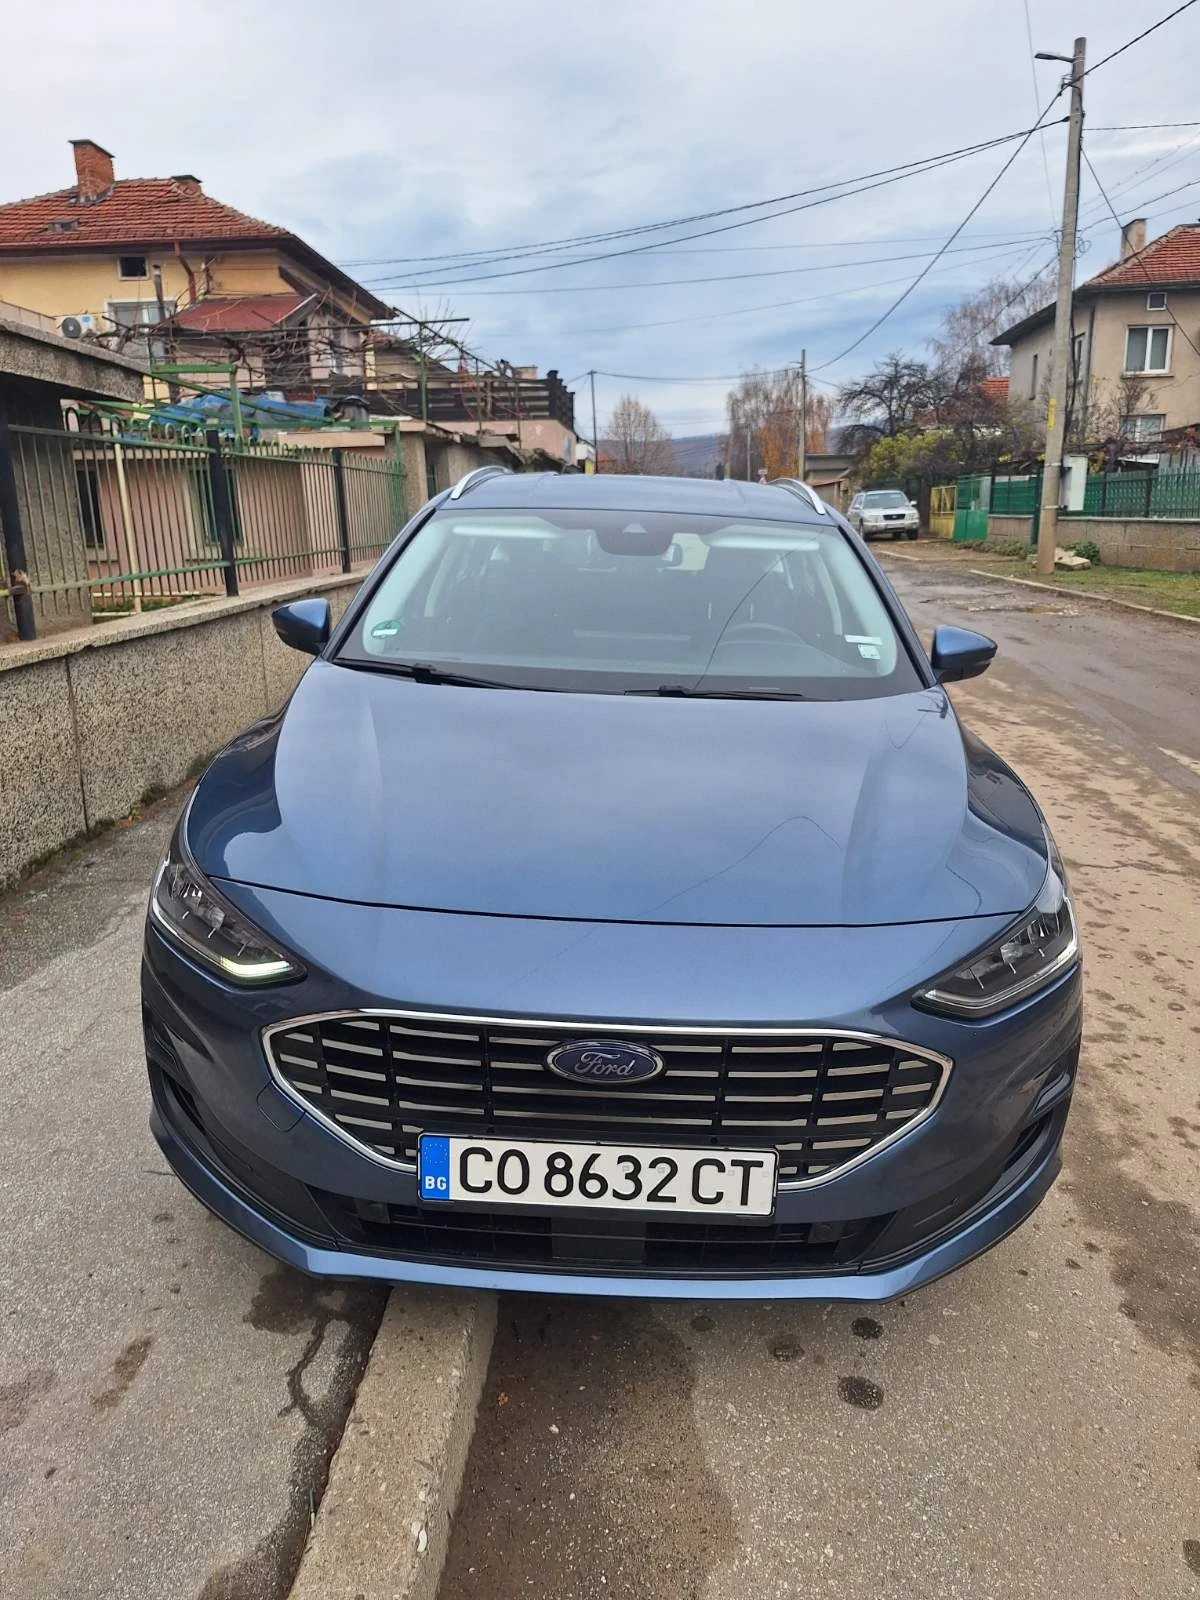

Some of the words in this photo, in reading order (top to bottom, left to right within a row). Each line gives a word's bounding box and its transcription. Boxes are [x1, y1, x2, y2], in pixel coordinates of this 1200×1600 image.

[574, 1051, 636, 1075] Ford
[425, 1175, 447, 1191] BG
[543, 1151, 679, 1204] 8632
[691, 1158, 764, 1206] CT
